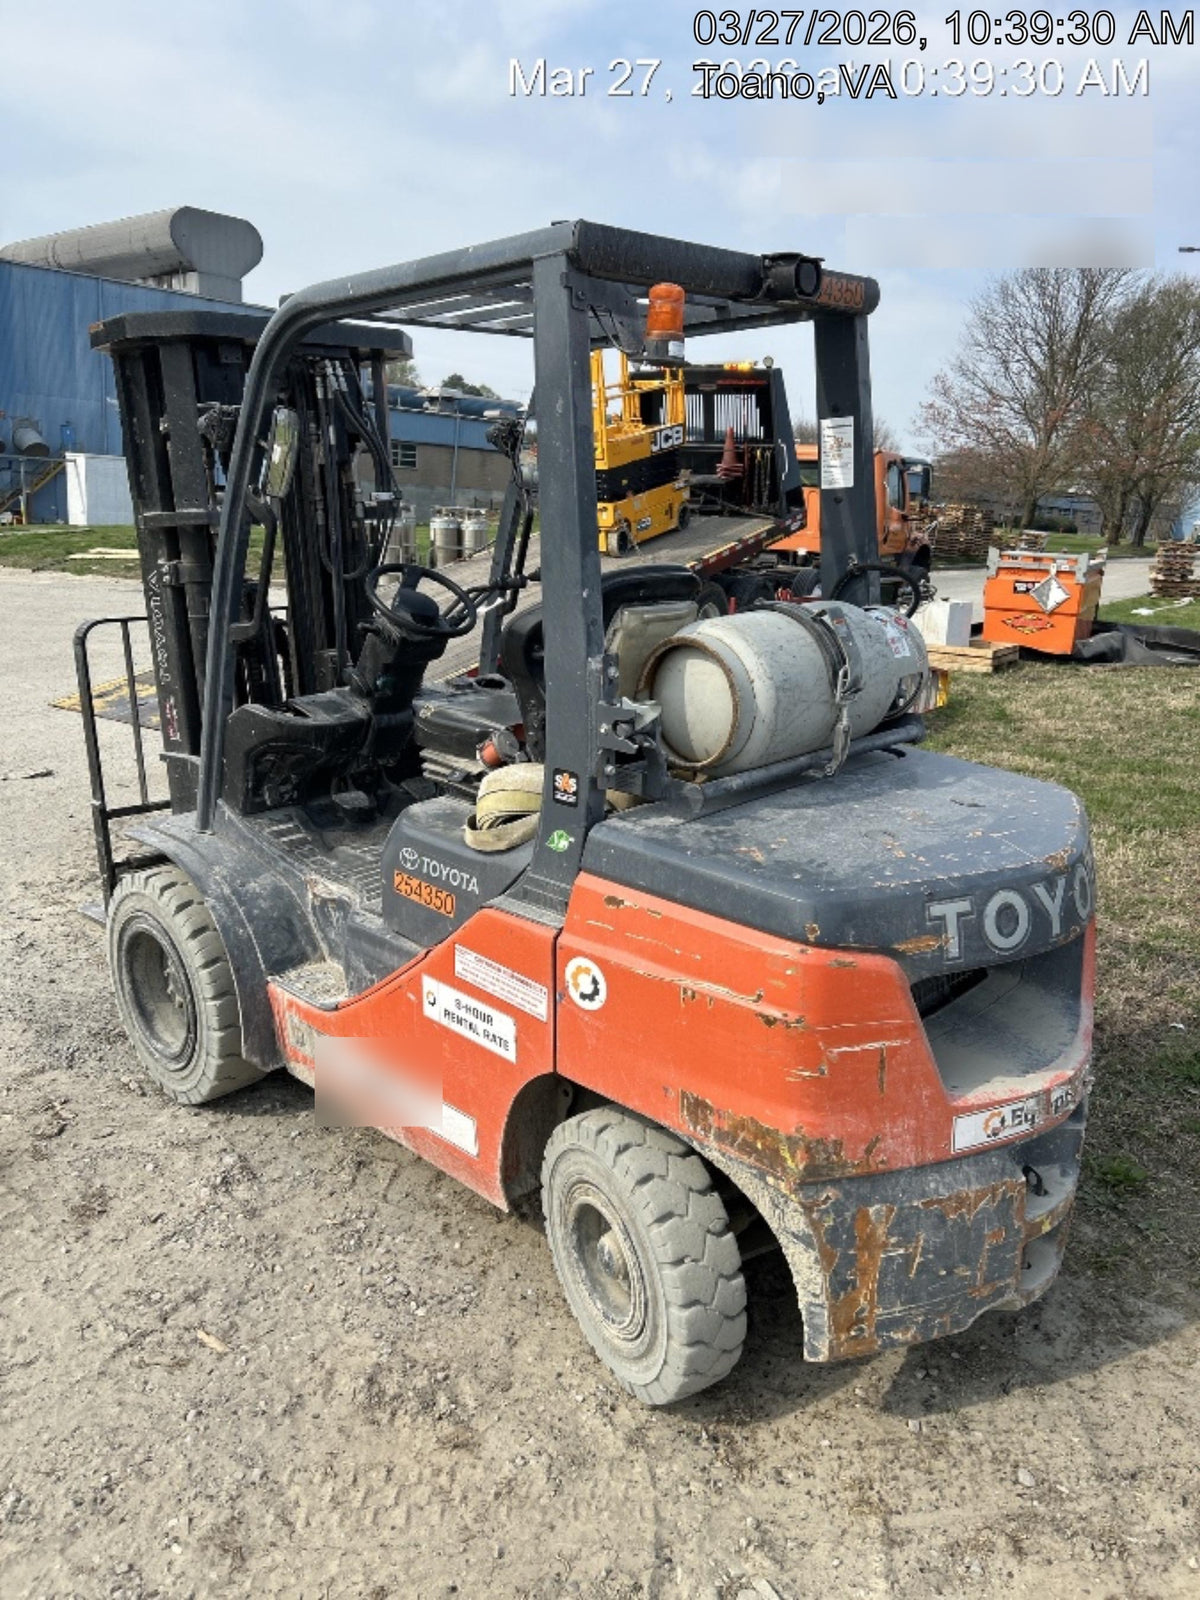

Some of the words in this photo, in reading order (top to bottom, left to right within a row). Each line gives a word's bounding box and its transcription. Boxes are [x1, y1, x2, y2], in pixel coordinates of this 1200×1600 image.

[817, 277, 865, 307] 4350
[651, 426, 684, 452] JCB
[395, 872, 455, 915] 254350
[421, 856, 479, 895] TOYOTA
[443, 1007, 481, 1038] RENTAL
[482, 1028, 510, 1052] RATE
